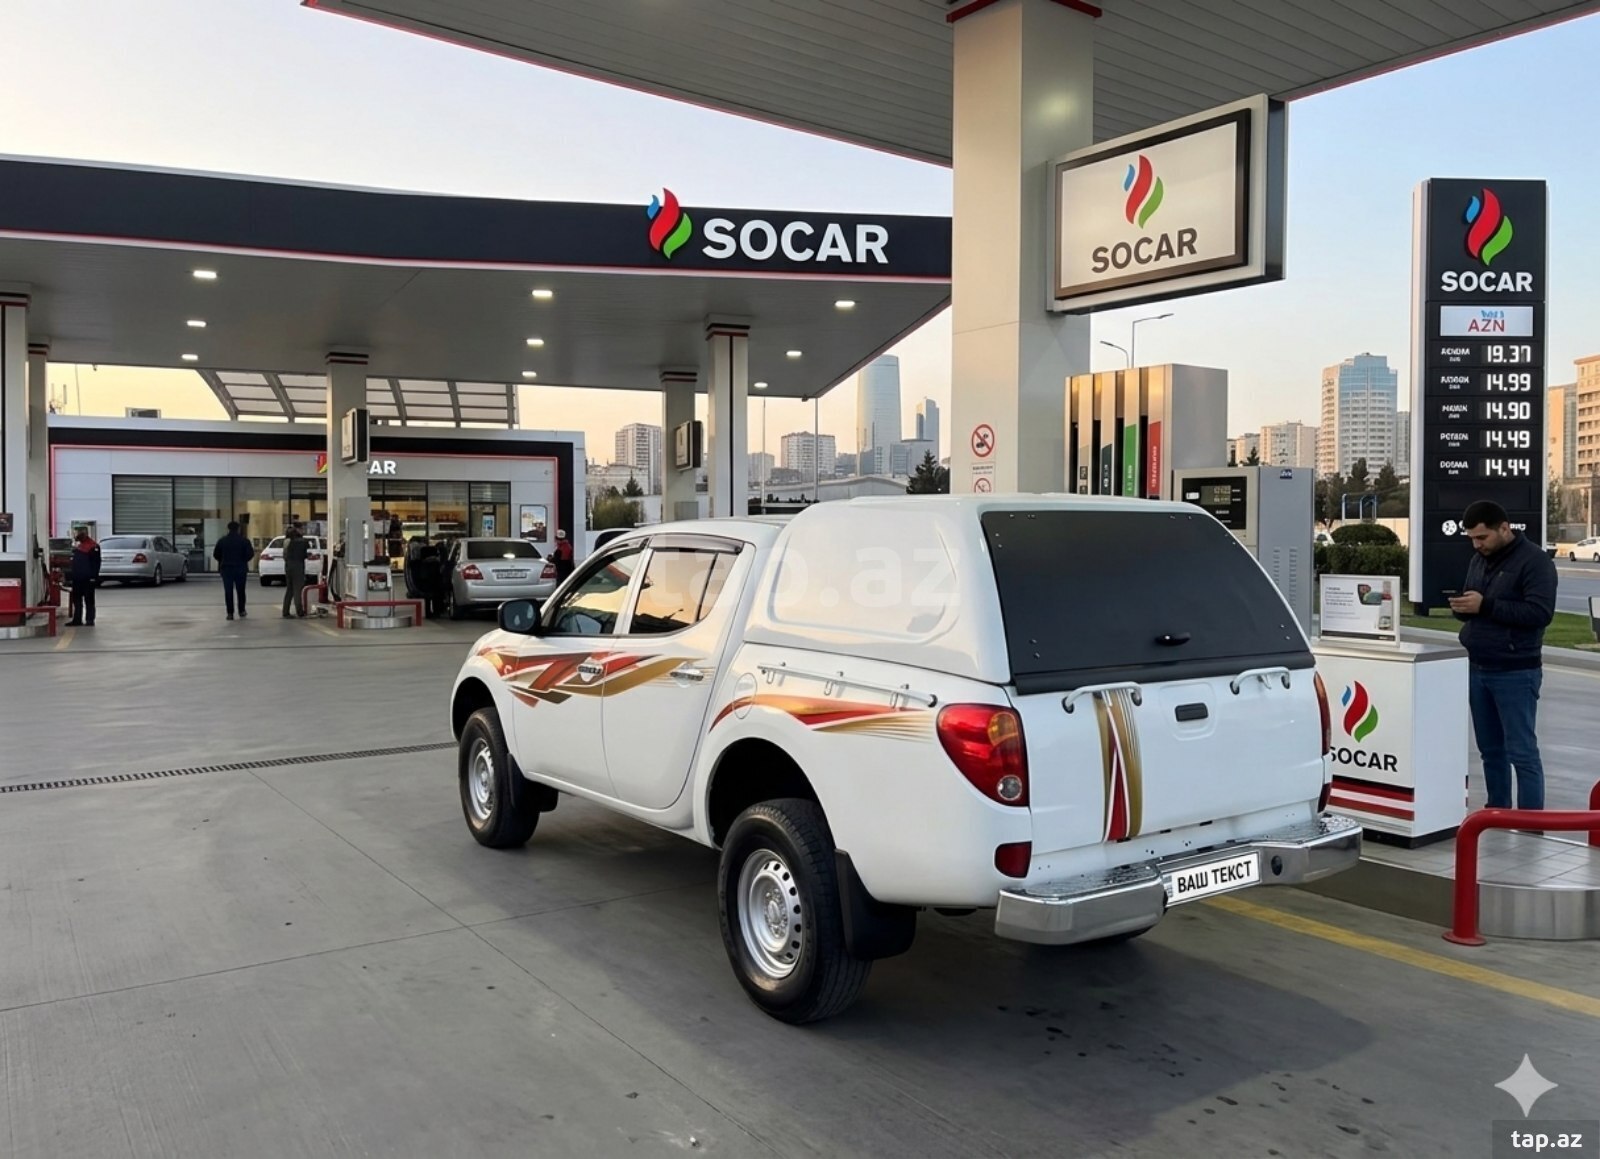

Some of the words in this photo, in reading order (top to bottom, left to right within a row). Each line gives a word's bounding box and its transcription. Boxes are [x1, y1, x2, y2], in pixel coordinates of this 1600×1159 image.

[702, 218, 889, 264] SOCAR
[1091, 227, 1198, 274] SOCAR
[1441, 271, 1533, 292] SOCAR
[1467, 318, 1505, 333] AZN
[1487, 344, 1531, 363] 19.37
[1487, 373, 1531, 391] 14.99
[1486, 402, 1531, 420] 14.90
[1486, 430, 1530, 448] 14.49
[1177, 871, 1209, 893] ВАШ
[1211, 860, 1252, 885] ТЕКСТ
